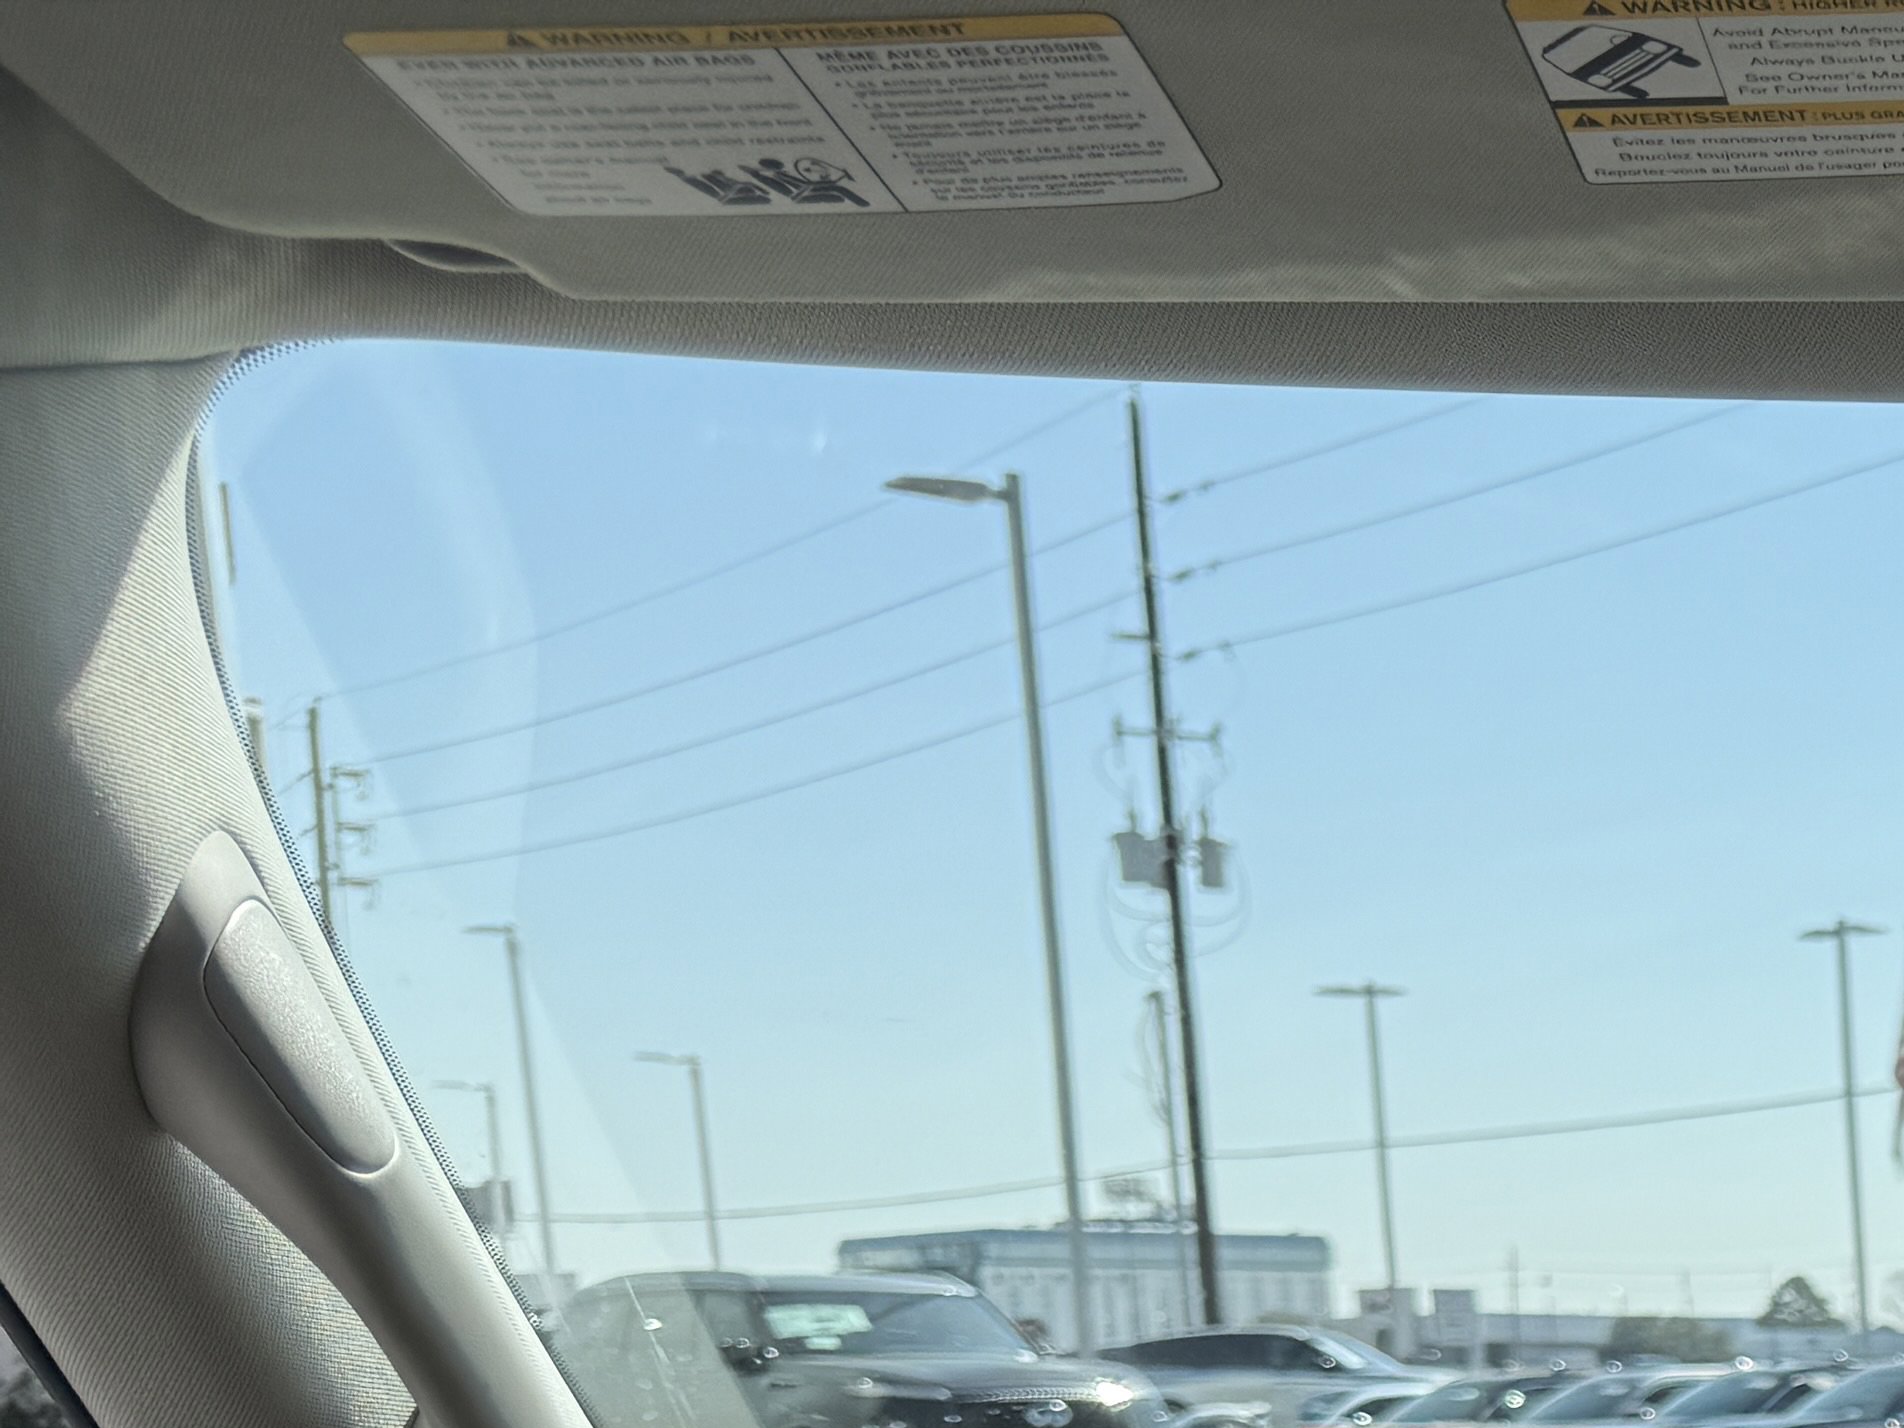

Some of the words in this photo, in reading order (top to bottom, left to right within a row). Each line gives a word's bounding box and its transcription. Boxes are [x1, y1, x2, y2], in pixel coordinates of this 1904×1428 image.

[1621, 0, 1771, 13] WARNING
[728, 22, 967, 43] AVERTISSEMENT
[1610, 110, 1807, 127] AVERTISSEMENT
[1821, 110, 1865, 122] PLUS
